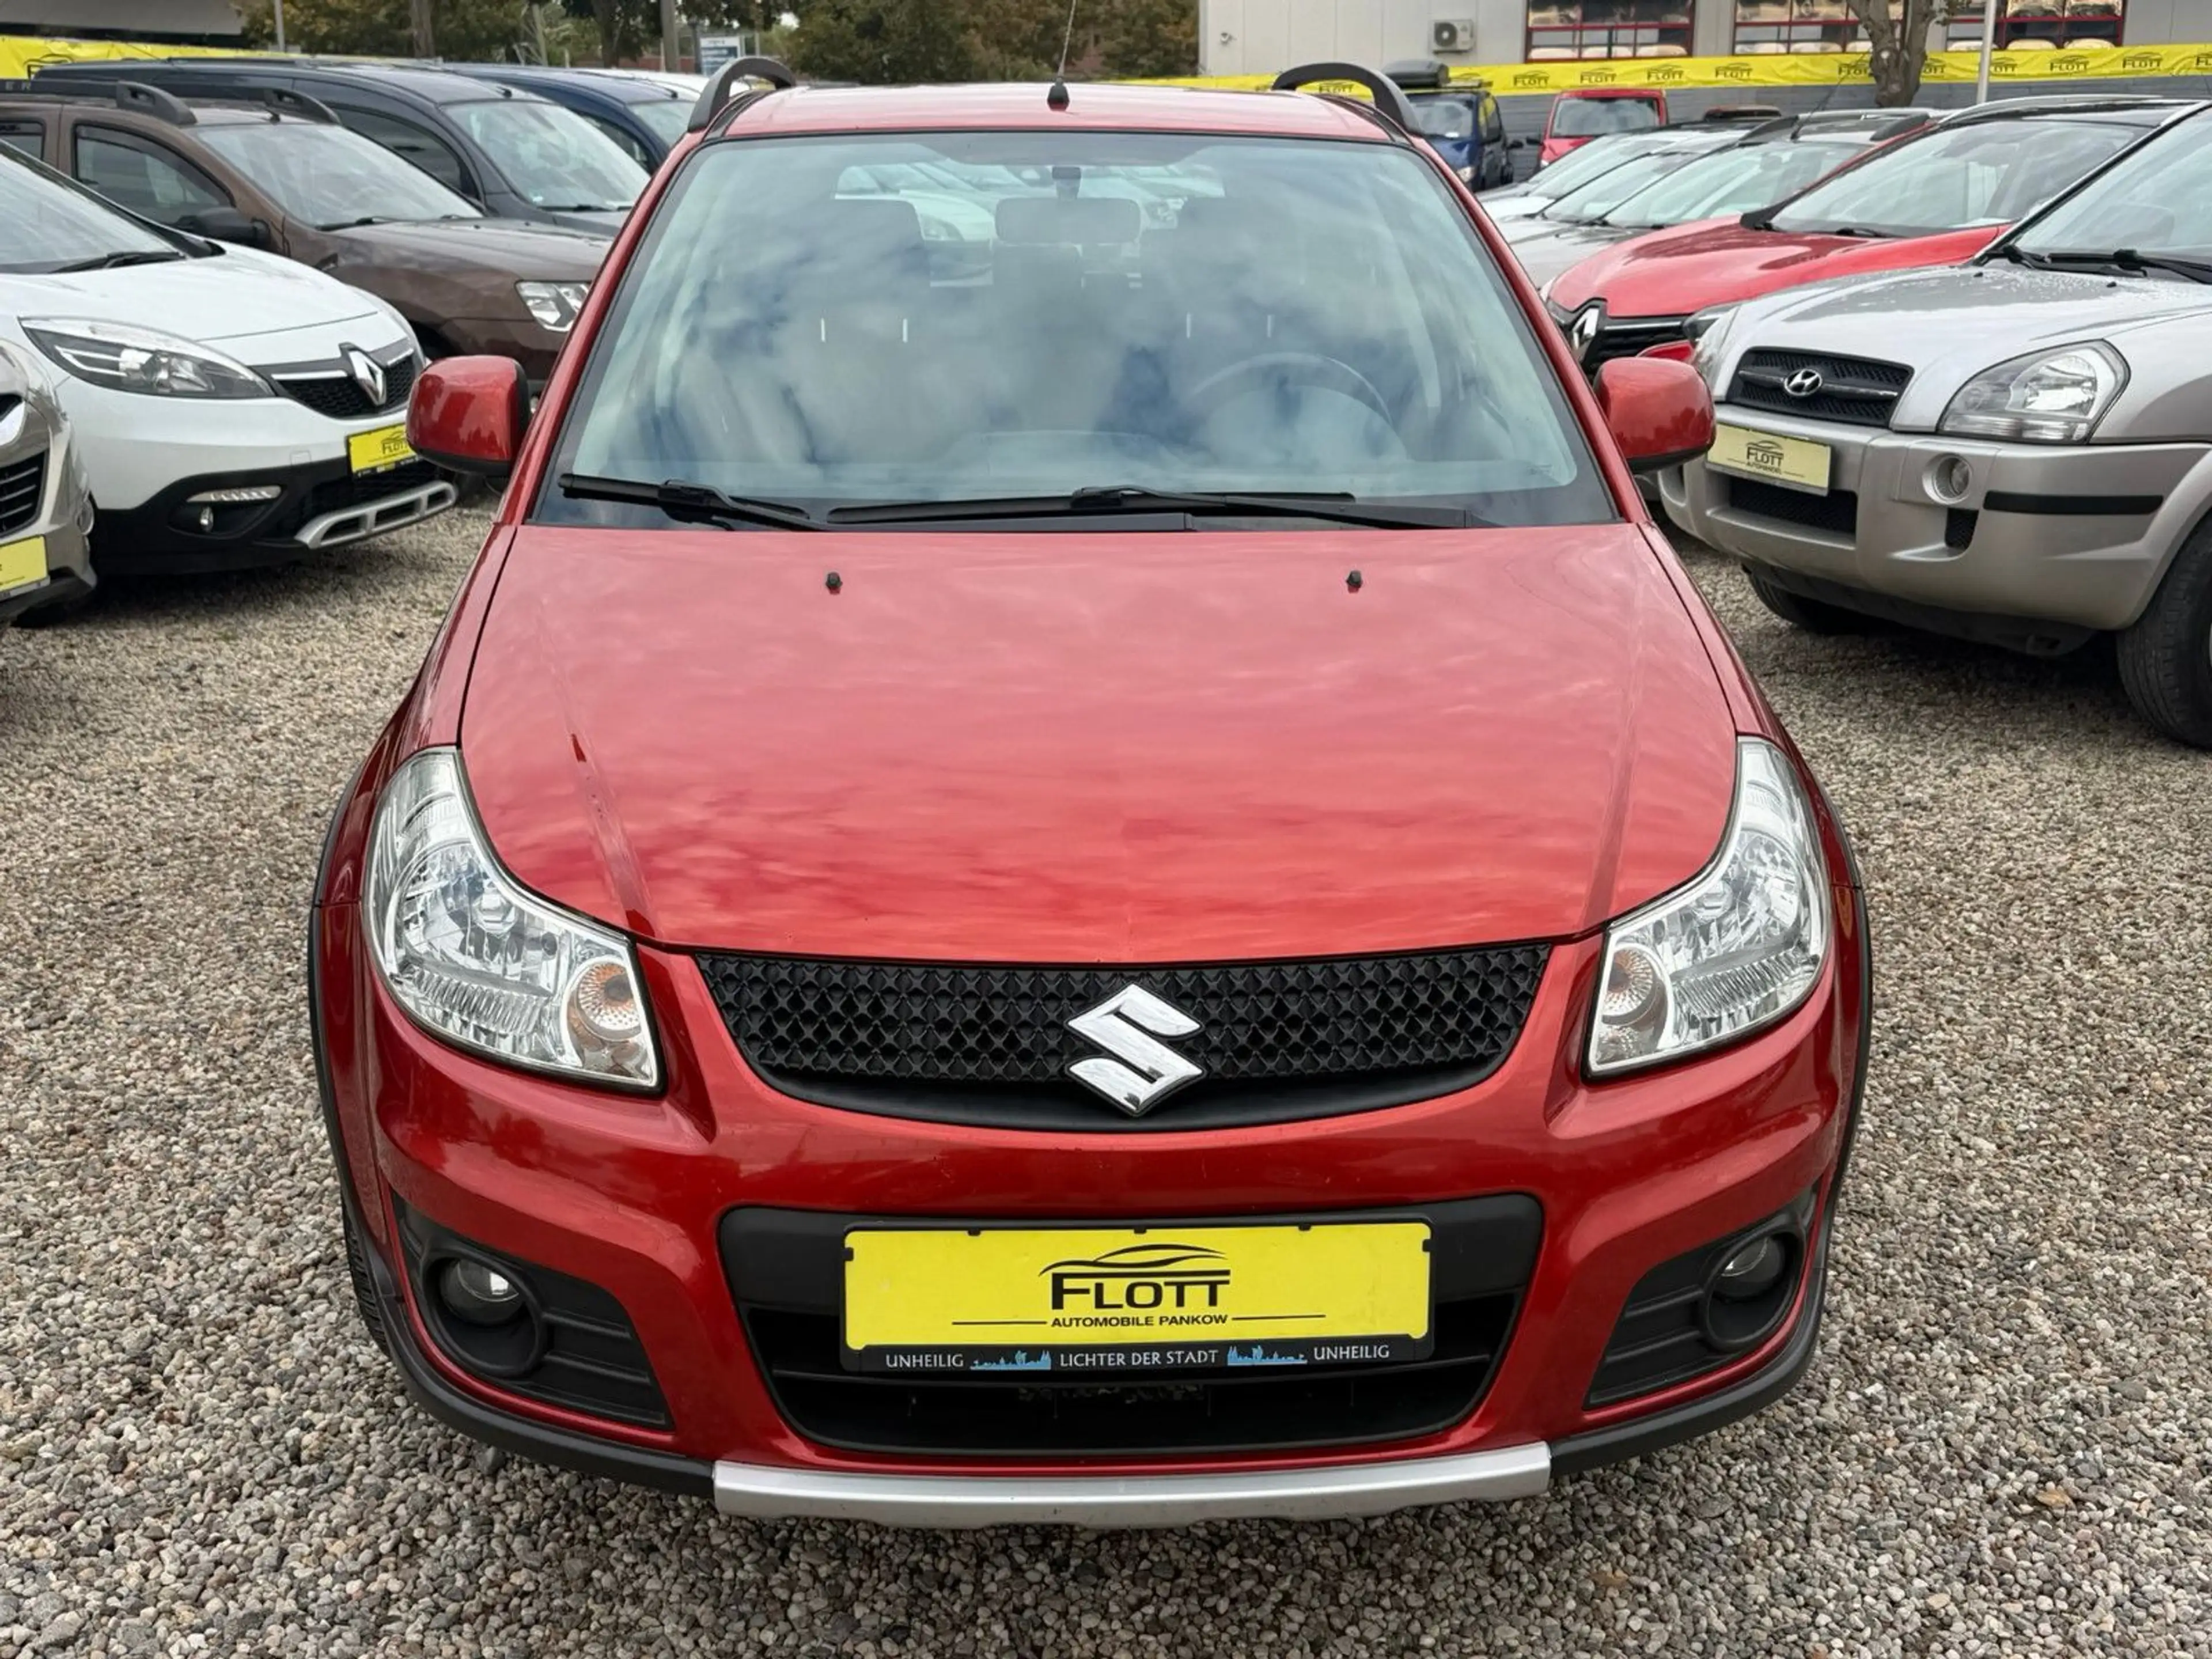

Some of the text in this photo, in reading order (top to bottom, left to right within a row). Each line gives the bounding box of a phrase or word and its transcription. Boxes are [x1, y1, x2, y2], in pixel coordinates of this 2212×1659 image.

[2050, 61, 2089, 71] FLOTT
[2122, 57, 2162, 69] FLOTT
[1580, 72, 1617, 84] FLOTT
[1647, 69, 1684, 81] FLOTT
[1715, 66, 1752, 78] FLOTT
[1514, 74, 1550, 86] FLOTT
[1747, 446, 1784, 467] FLOTT
[1051, 1269, 1231, 1310] FLOTT
[1051, 1315, 1228, 1327] AUTOMOBILE PANKOW
[885, 1345, 1389, 1368] UNHEILIG LICHTER DER STADT UNHEILIG
